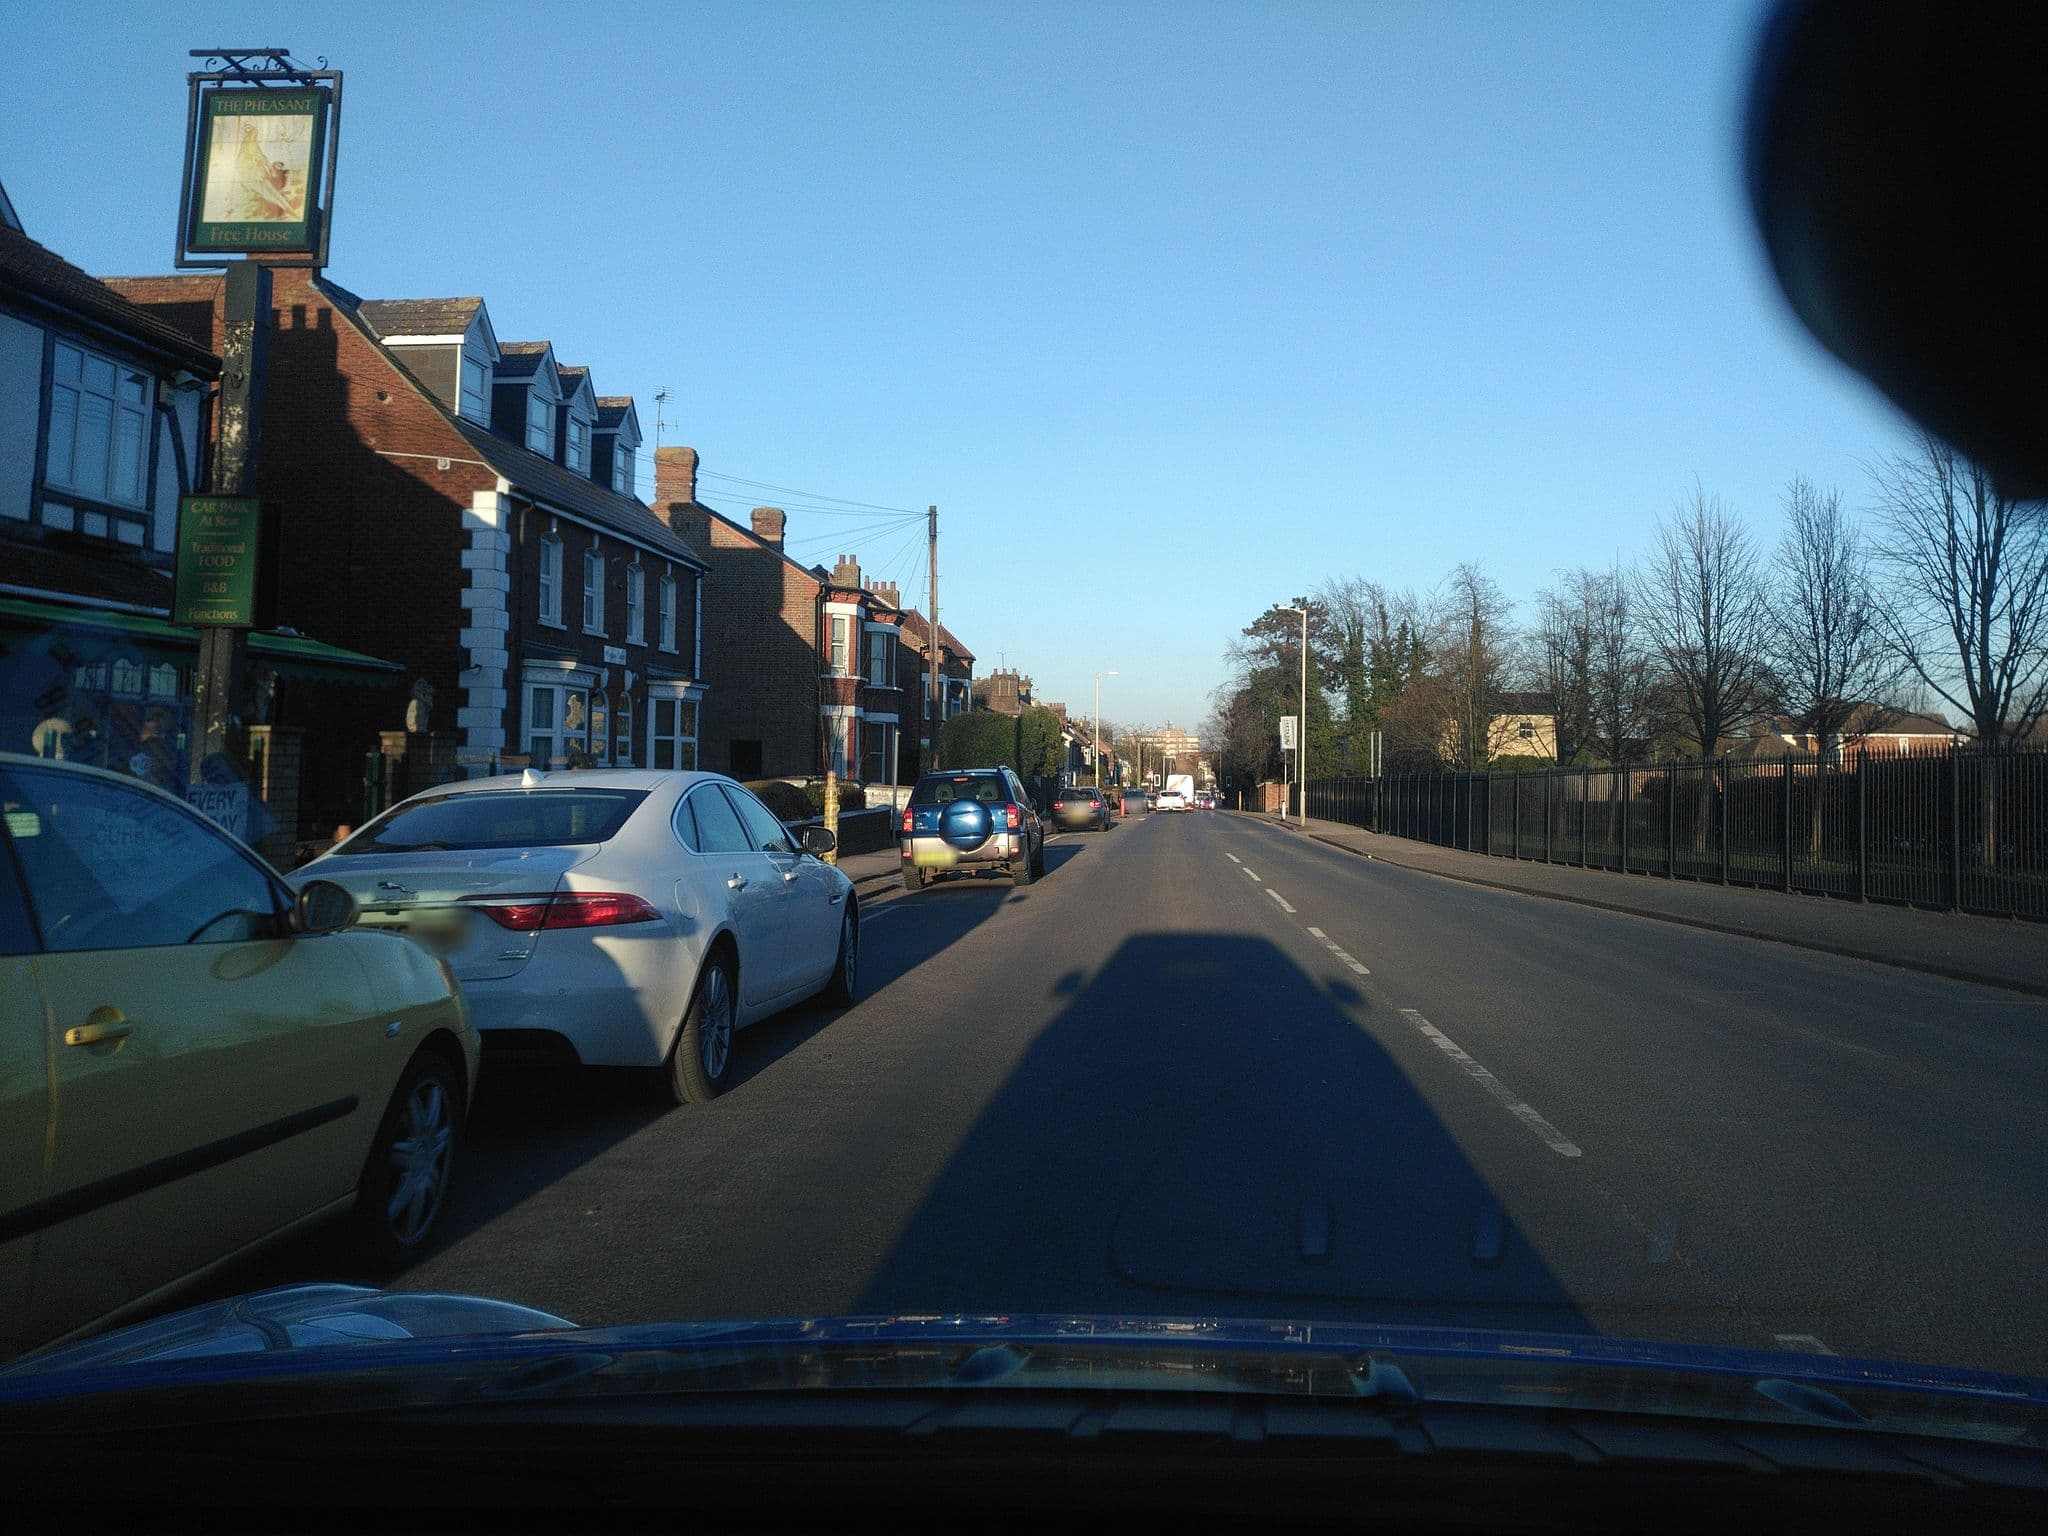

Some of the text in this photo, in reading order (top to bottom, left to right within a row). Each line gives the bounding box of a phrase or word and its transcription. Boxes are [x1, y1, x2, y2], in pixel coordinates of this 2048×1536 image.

[216, 99, 313, 113] THE PHEASANT
[211, 226, 289, 241] Free House
[191, 502, 217, 513] CAR
[199, 556, 235, 567] FOOD
[188, 607, 239, 620] Functions
[188, 790, 237, 811] EVERY
